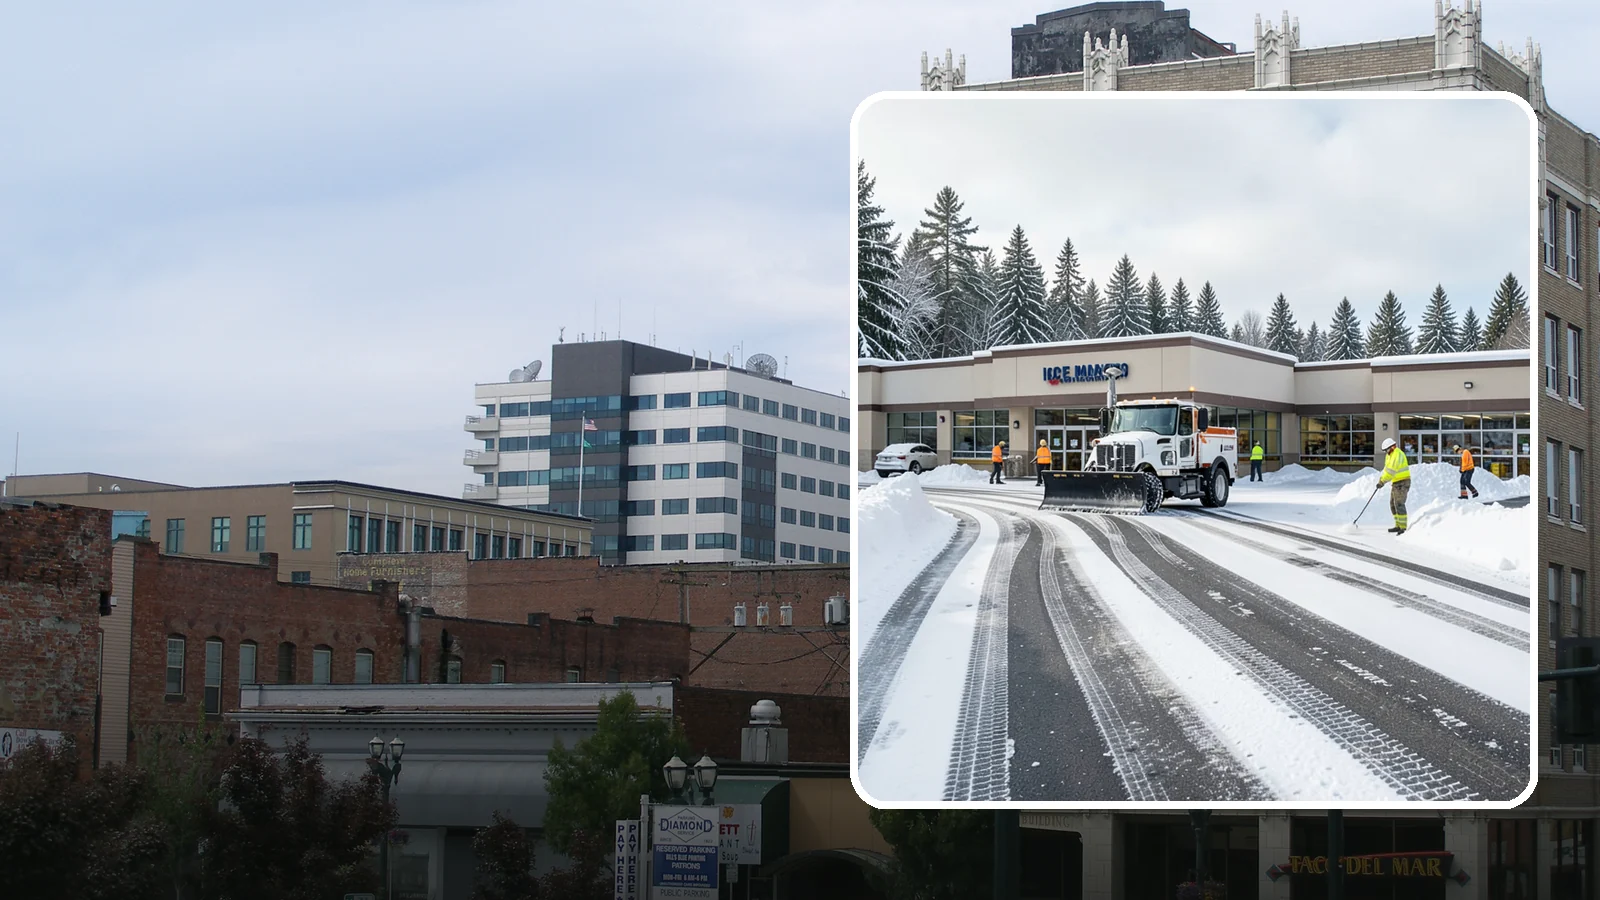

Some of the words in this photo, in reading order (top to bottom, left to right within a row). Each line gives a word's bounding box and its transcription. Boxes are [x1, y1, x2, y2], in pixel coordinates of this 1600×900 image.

[370, 566, 427, 577] Furnishers
[660, 818, 713, 833] DIAMOND
[1021, 815, 1070, 828] BUILDING
[628, 825, 636, 852] PAY
[656, 845, 688, 853] RESERVED
[689, 846, 716, 854] PARKING
[671, 862, 701, 870] PATRONS
[1289, 855, 1329, 874] TAC
[1346, 856, 1384, 876] DEL
[1392, 857, 1442, 877] MAR
[617, 855, 625, 893] HERE
[628, 855, 636, 893] HERE
[660, 888, 682, 897] PUBLIC
[683, 889, 710, 898] PARKING
